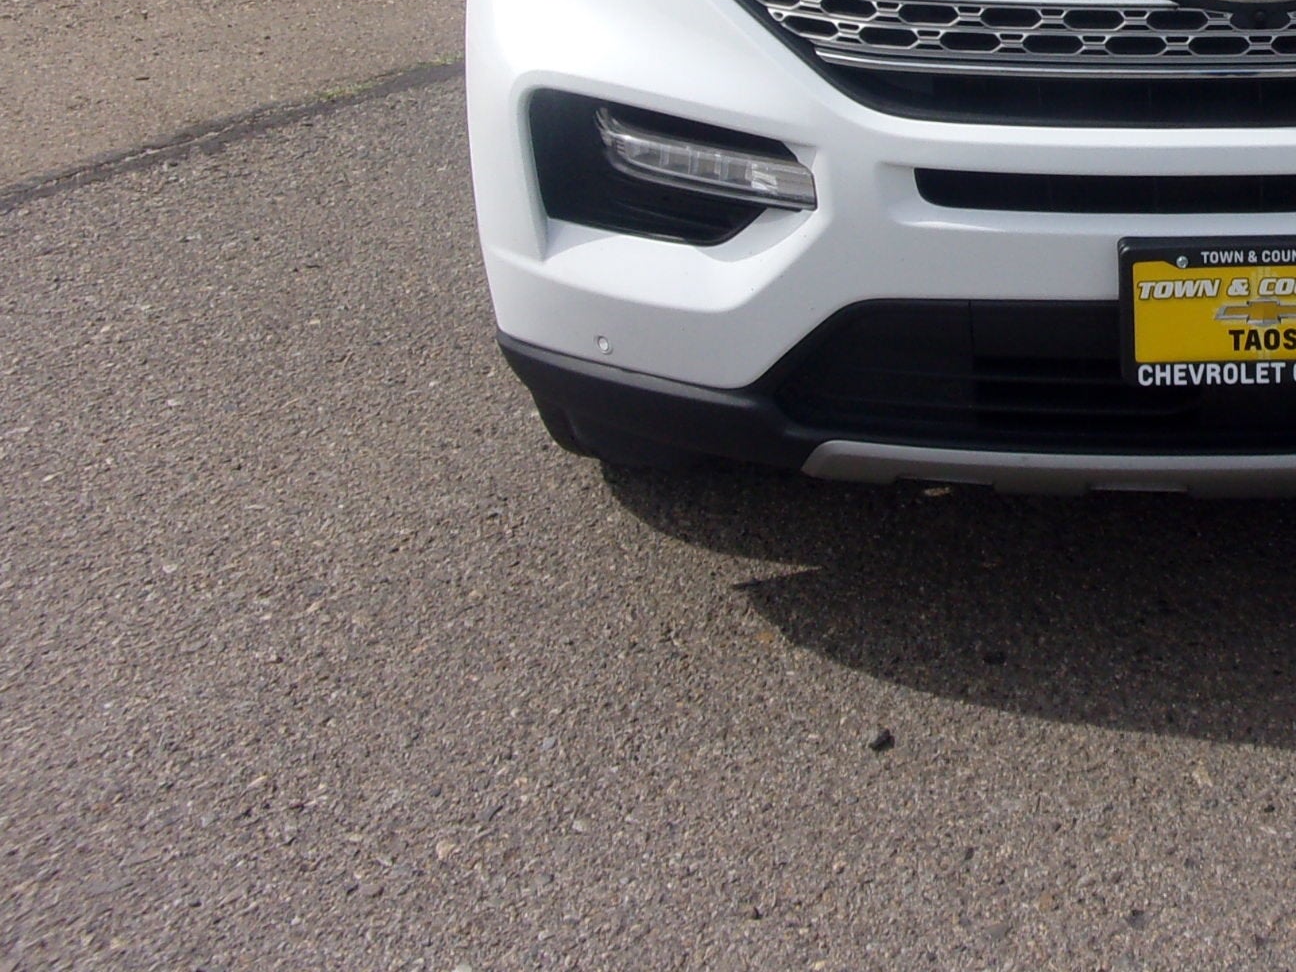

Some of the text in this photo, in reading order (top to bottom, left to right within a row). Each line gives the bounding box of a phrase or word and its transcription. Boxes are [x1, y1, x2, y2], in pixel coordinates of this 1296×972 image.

[1201, 251, 1245, 265] TOWN
[1247, 251, 1258, 263] &
[1137, 278, 1221, 301] TOWN
[1226, 277, 1250, 297] &
[1138, 362, 1286, 386] CHEVROLET
